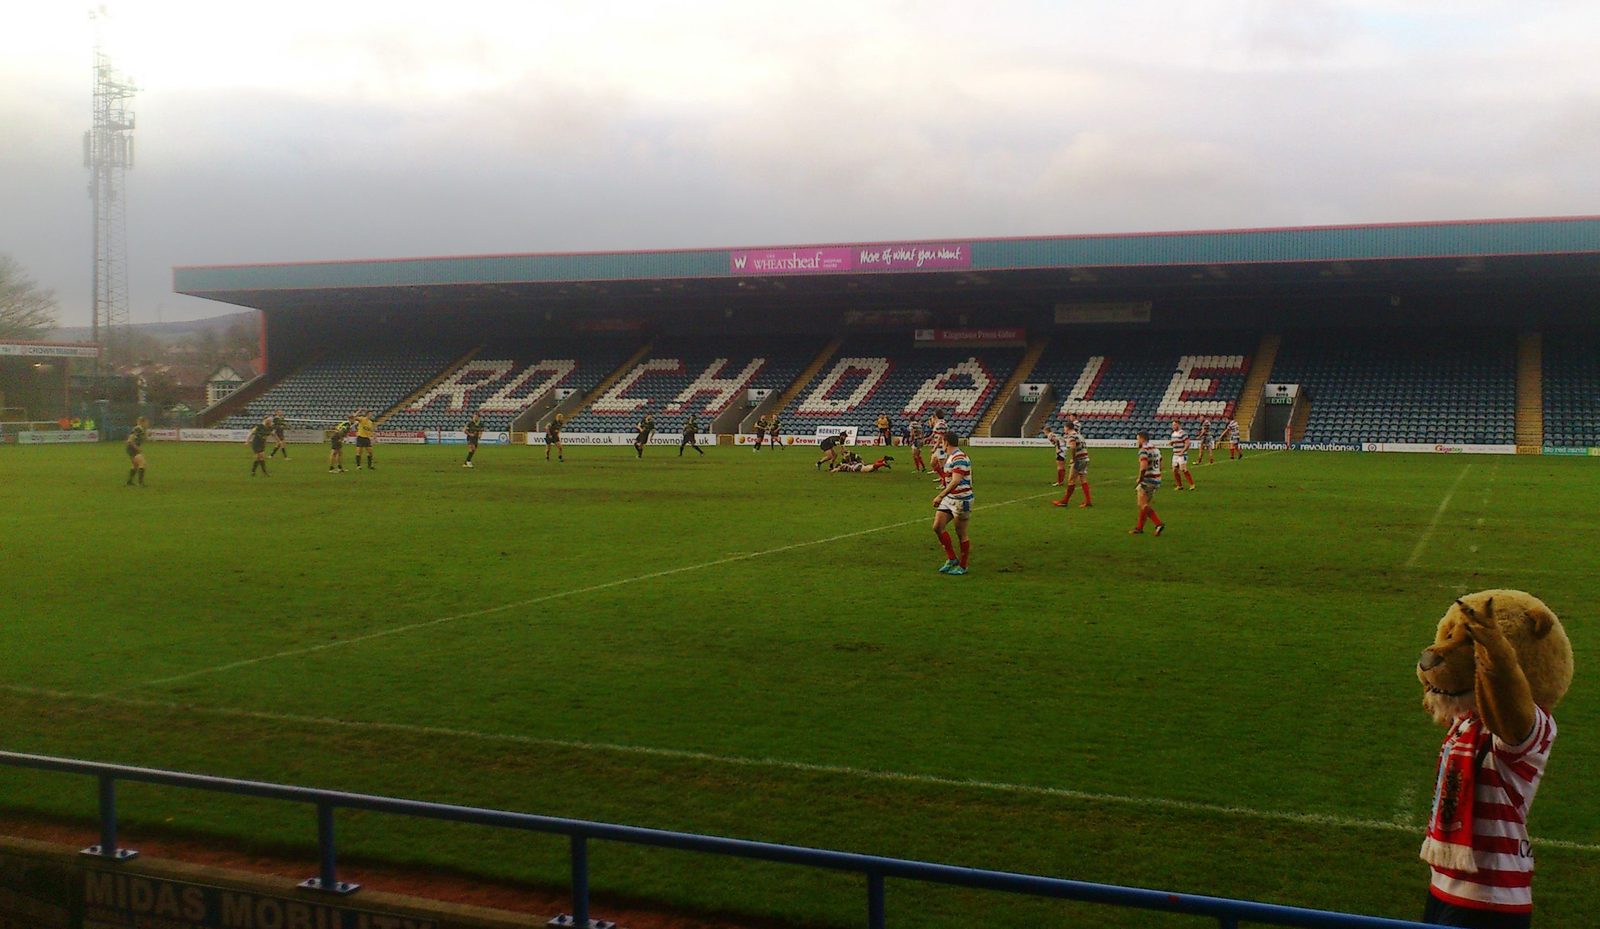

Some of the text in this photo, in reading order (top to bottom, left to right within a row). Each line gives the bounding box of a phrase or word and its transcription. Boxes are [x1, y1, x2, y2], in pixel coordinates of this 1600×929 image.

[860, 249, 880, 264] More
[882, 248, 892, 265] of
[893, 248, 916, 261] what
[917, 250, 936, 267] you
